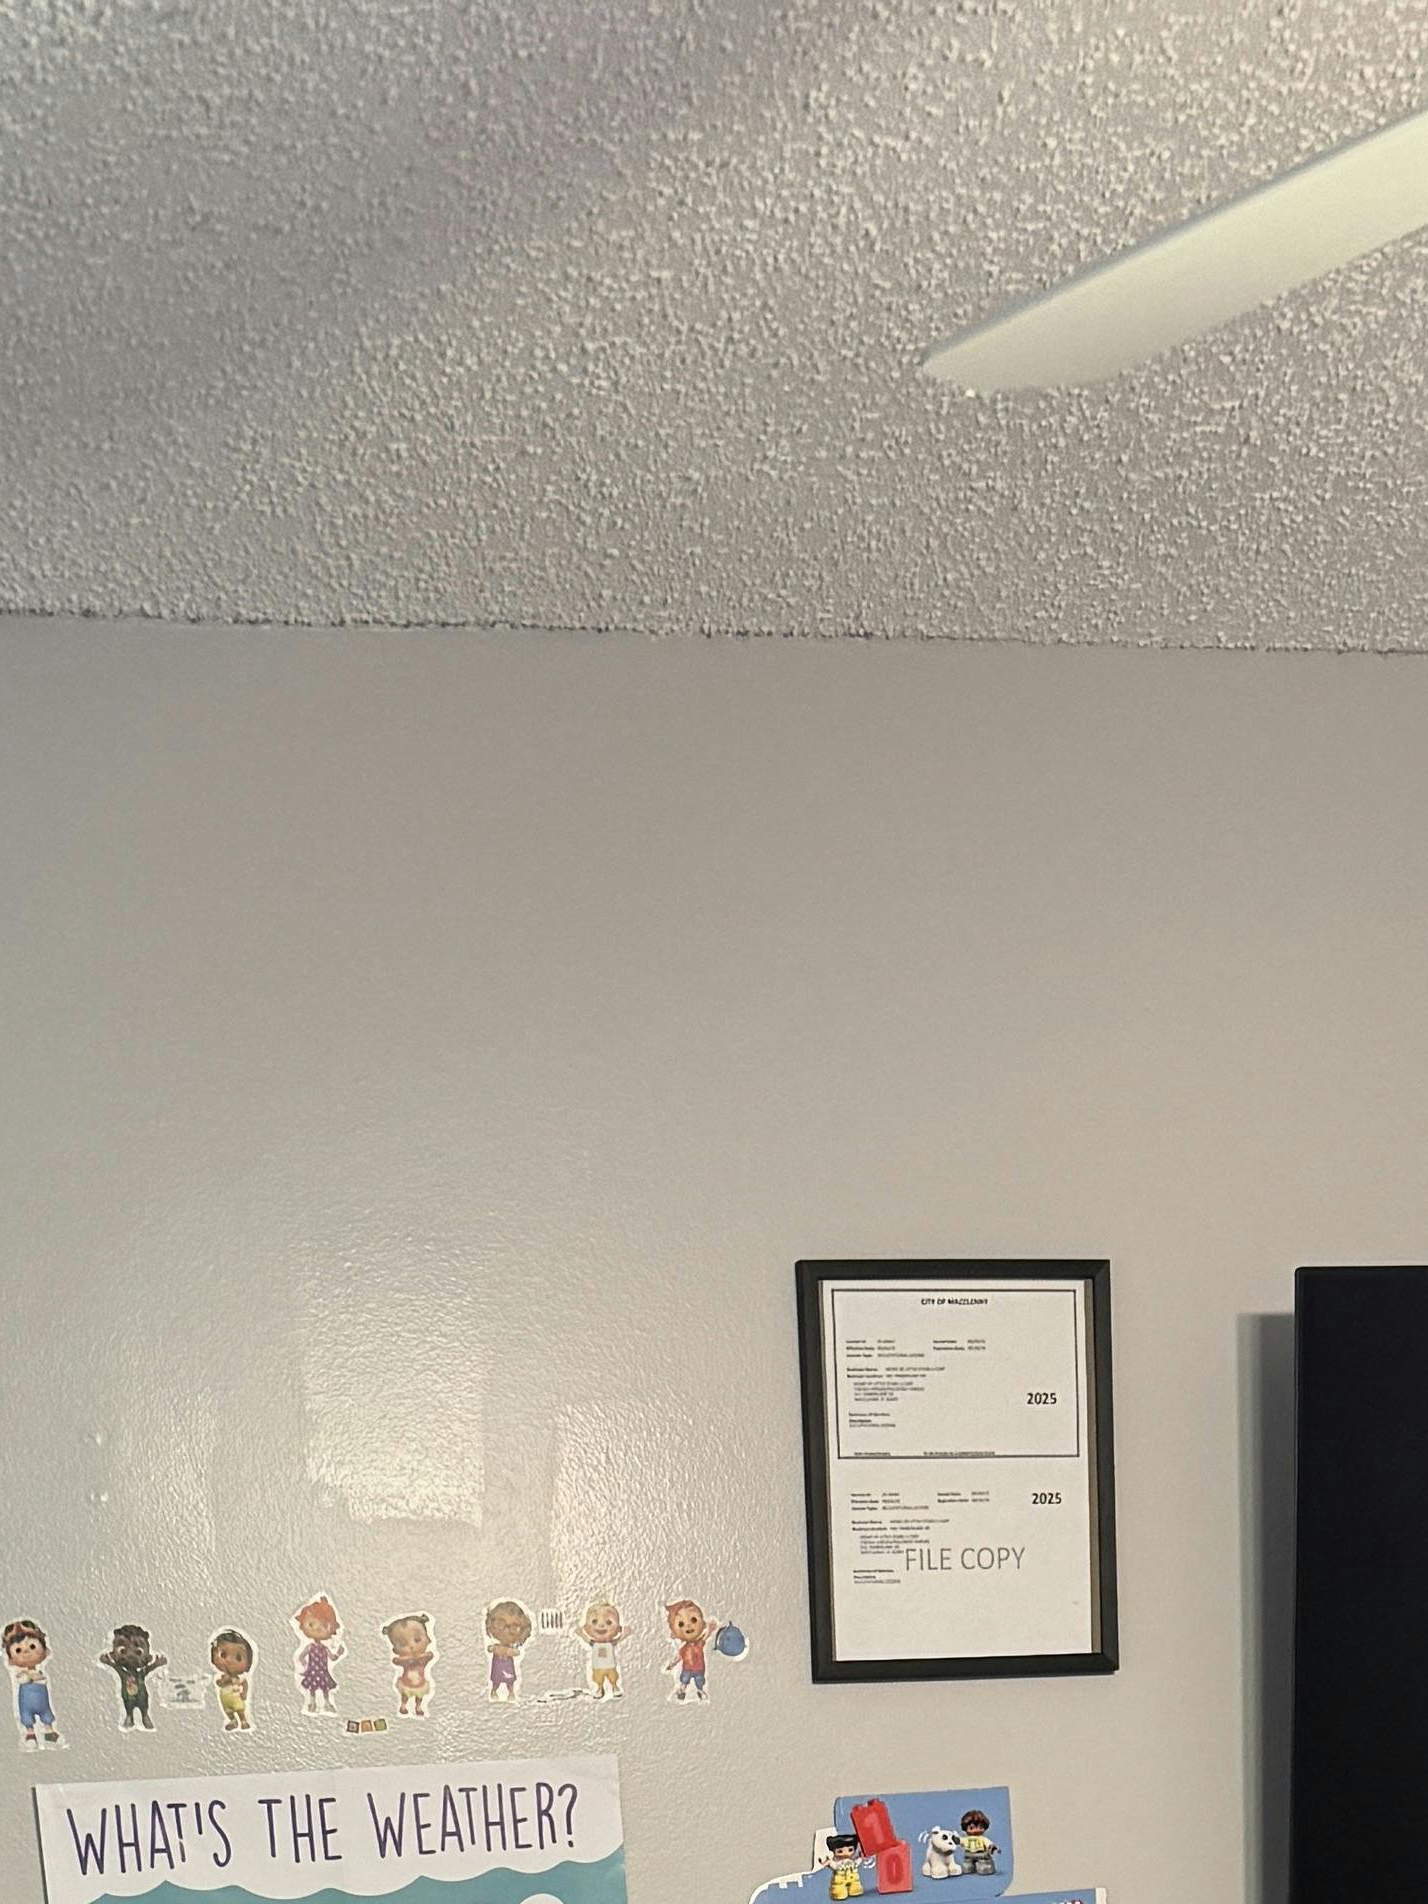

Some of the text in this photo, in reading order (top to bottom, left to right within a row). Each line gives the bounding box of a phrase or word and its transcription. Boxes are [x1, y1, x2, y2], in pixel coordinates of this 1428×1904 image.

[1027, 1392, 1058, 1405] 2025
[1031, 1492, 1062, 1505] 2025
[905, 1546, 1026, 1572] FILE COPY
[66, 1782, 579, 1876] WHAT'S THE WEATHER?
